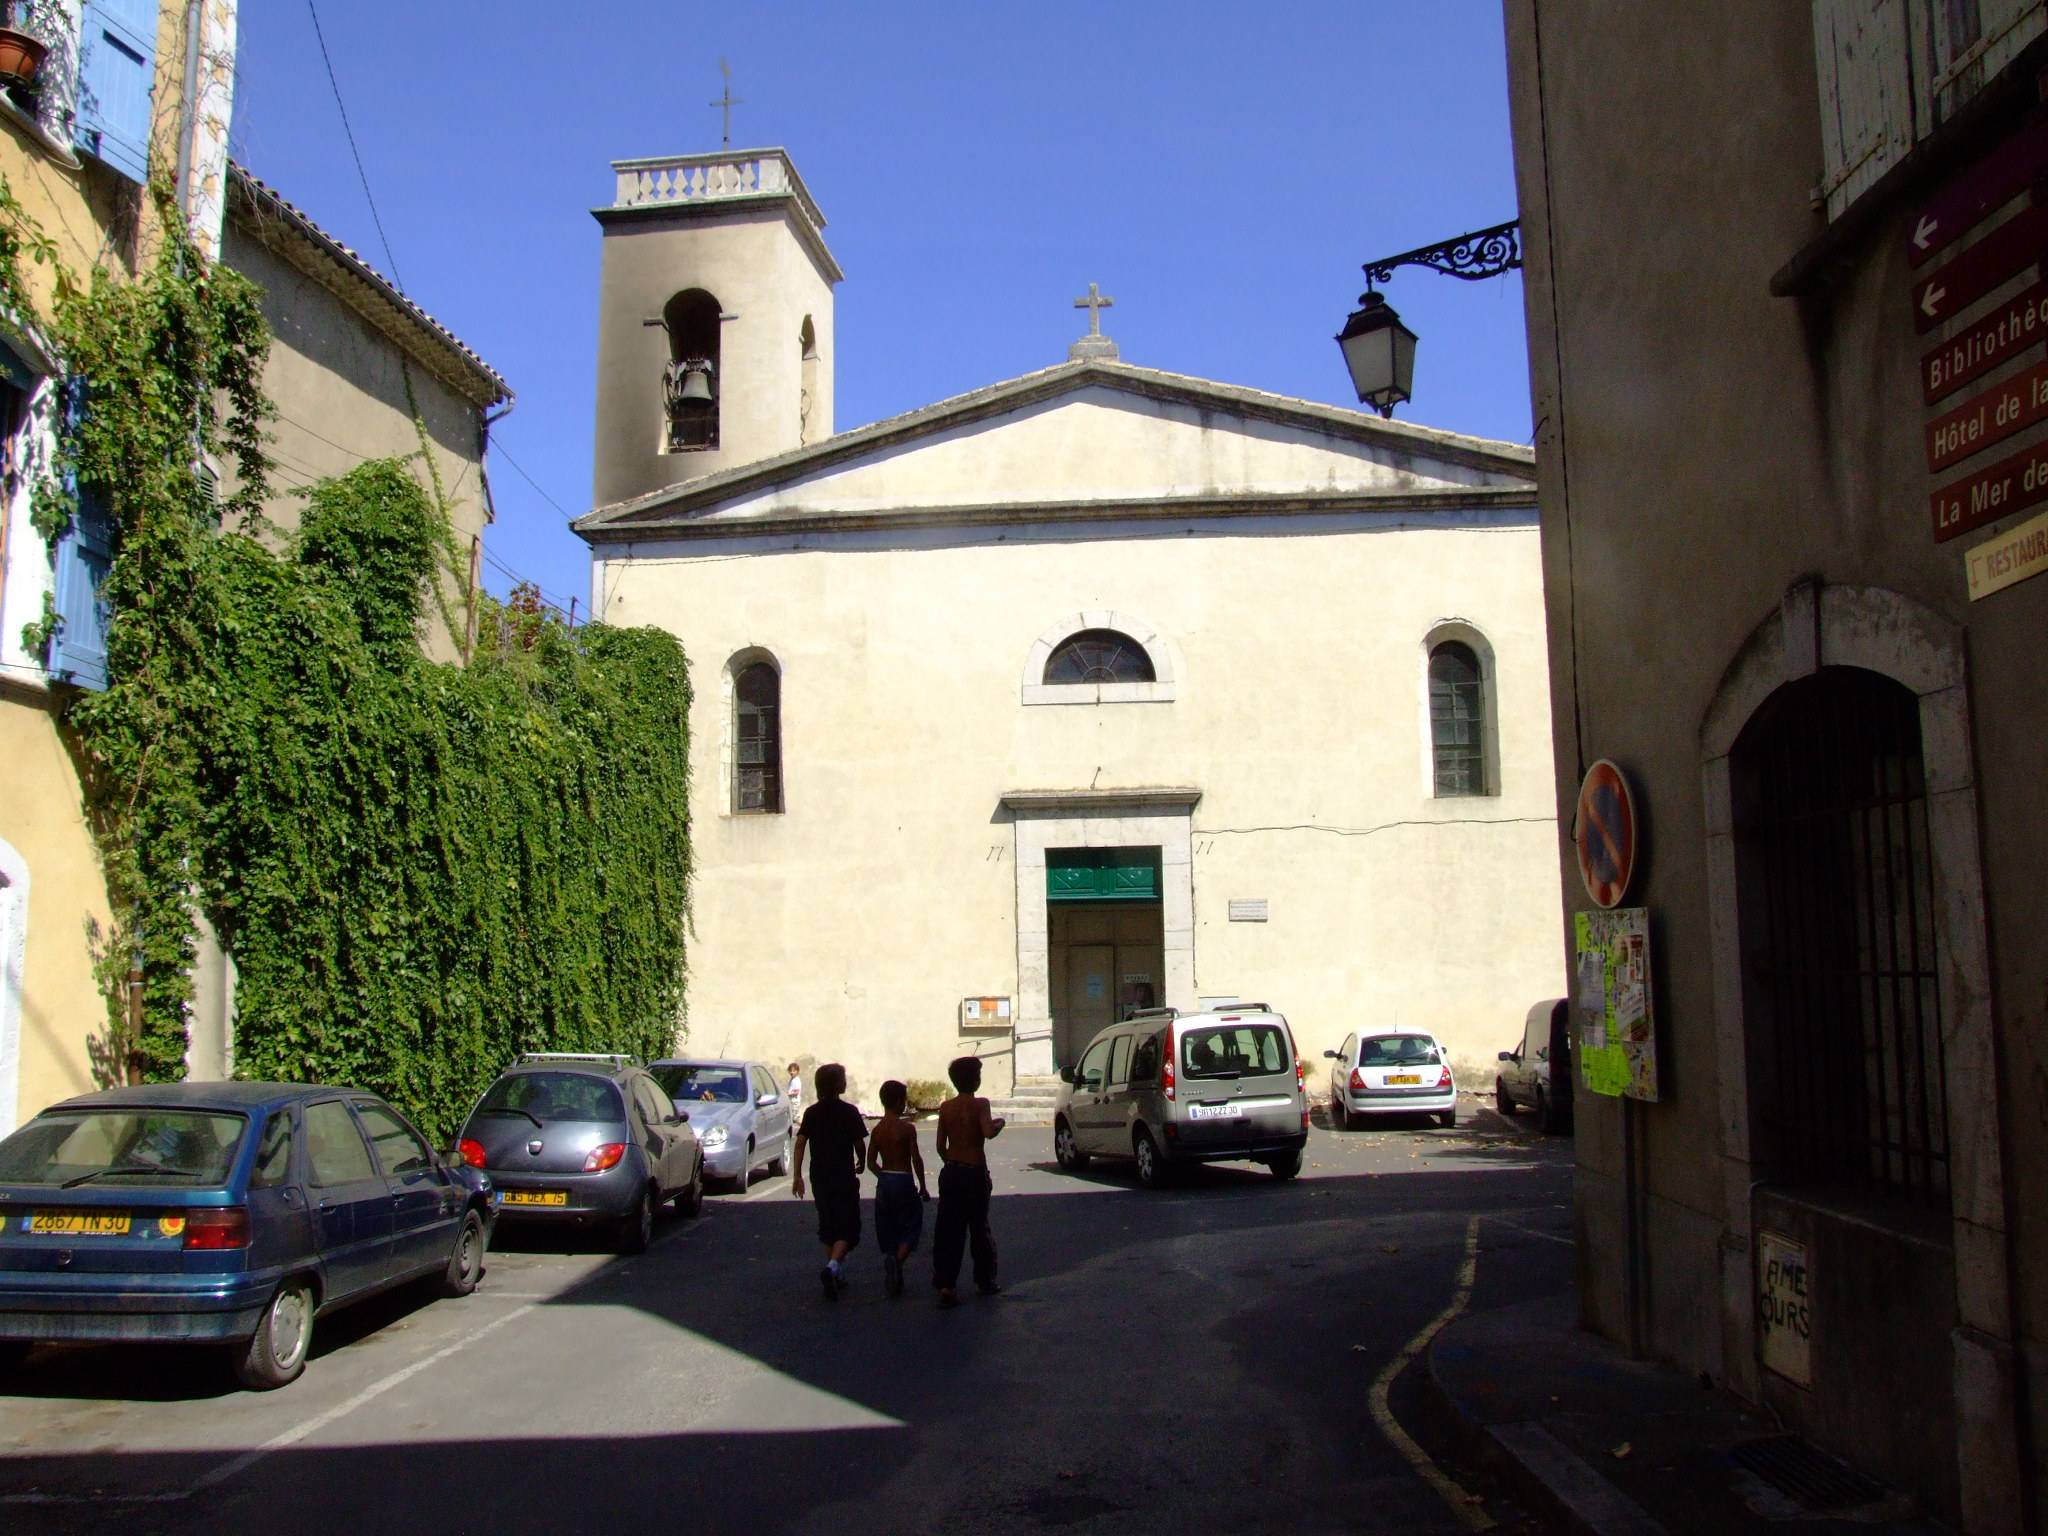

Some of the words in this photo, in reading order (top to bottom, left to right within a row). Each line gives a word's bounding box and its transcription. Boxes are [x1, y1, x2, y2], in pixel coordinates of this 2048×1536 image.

[1935, 407, 1985, 460] Hôtel
[1996, 394, 2020, 427] de
[1939, 500, 1960, 529] La
[1970, 479, 2011, 516] Mer
[2023, 459, 2048, 493] de
[1987, 526, 2048, 580] RESTAUR
[82, 1211, 101, 1230] YN
[104, 1211, 127, 1230] 30
